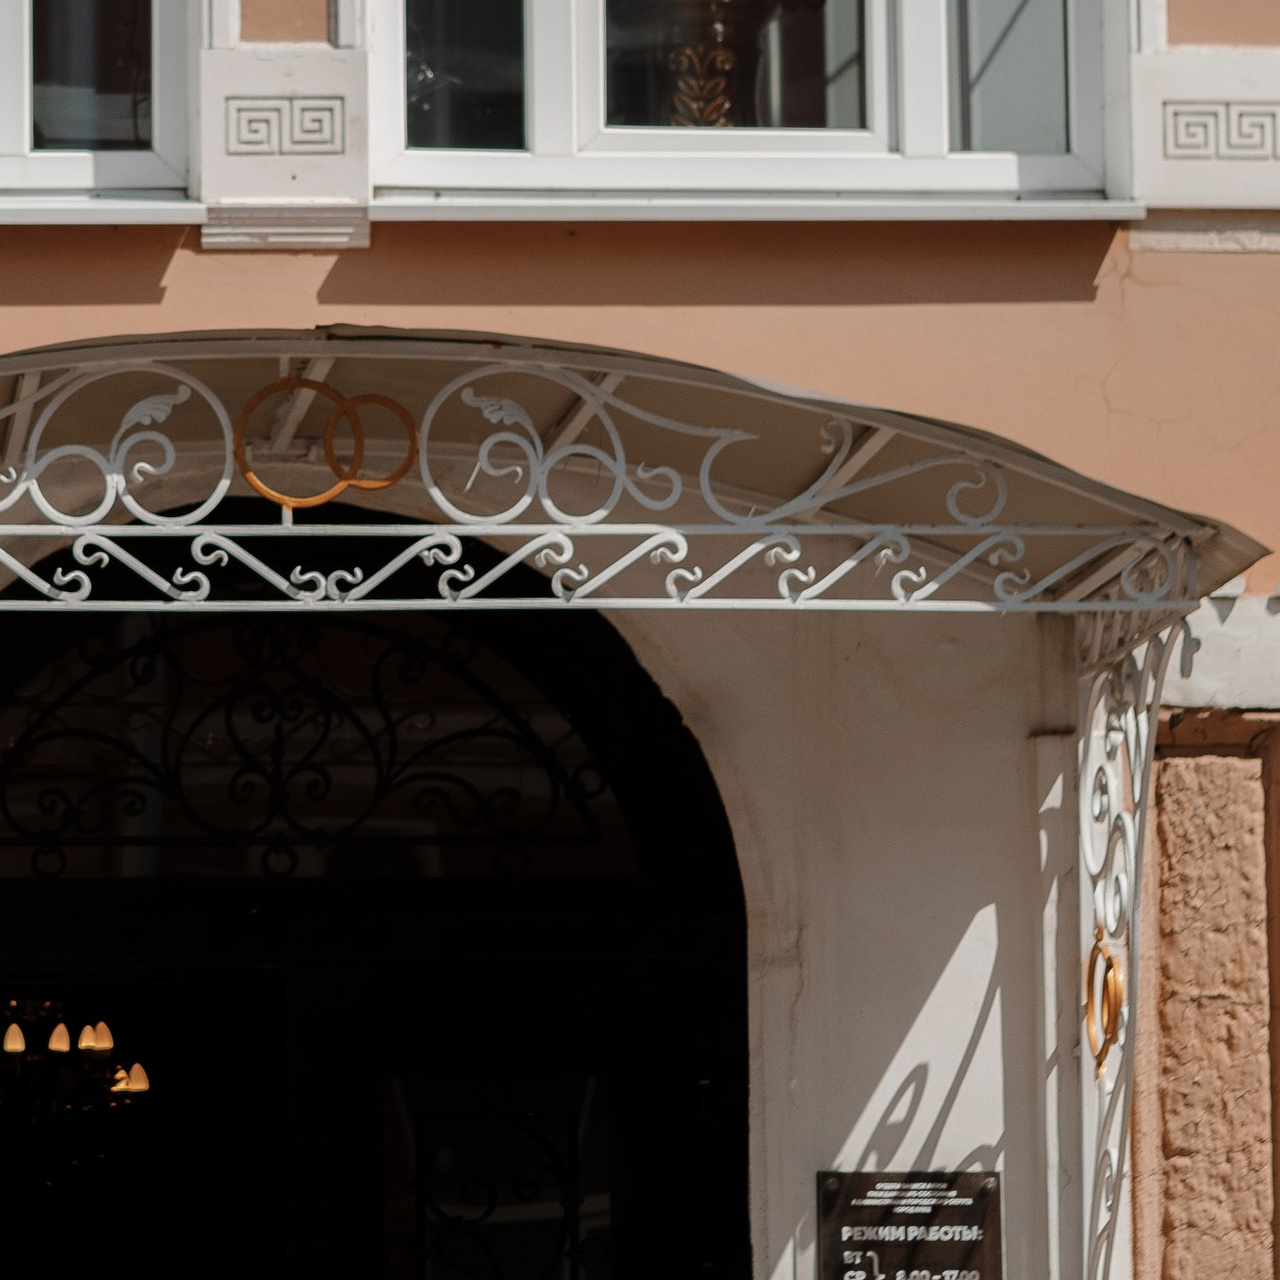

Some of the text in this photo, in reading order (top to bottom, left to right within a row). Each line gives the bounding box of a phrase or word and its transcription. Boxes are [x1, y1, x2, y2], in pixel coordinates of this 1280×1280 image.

[841, 1226, 984, 1241] РЕЖИМ РАБОТЫ:
[843, 1251, 864, 1264] ВТ
